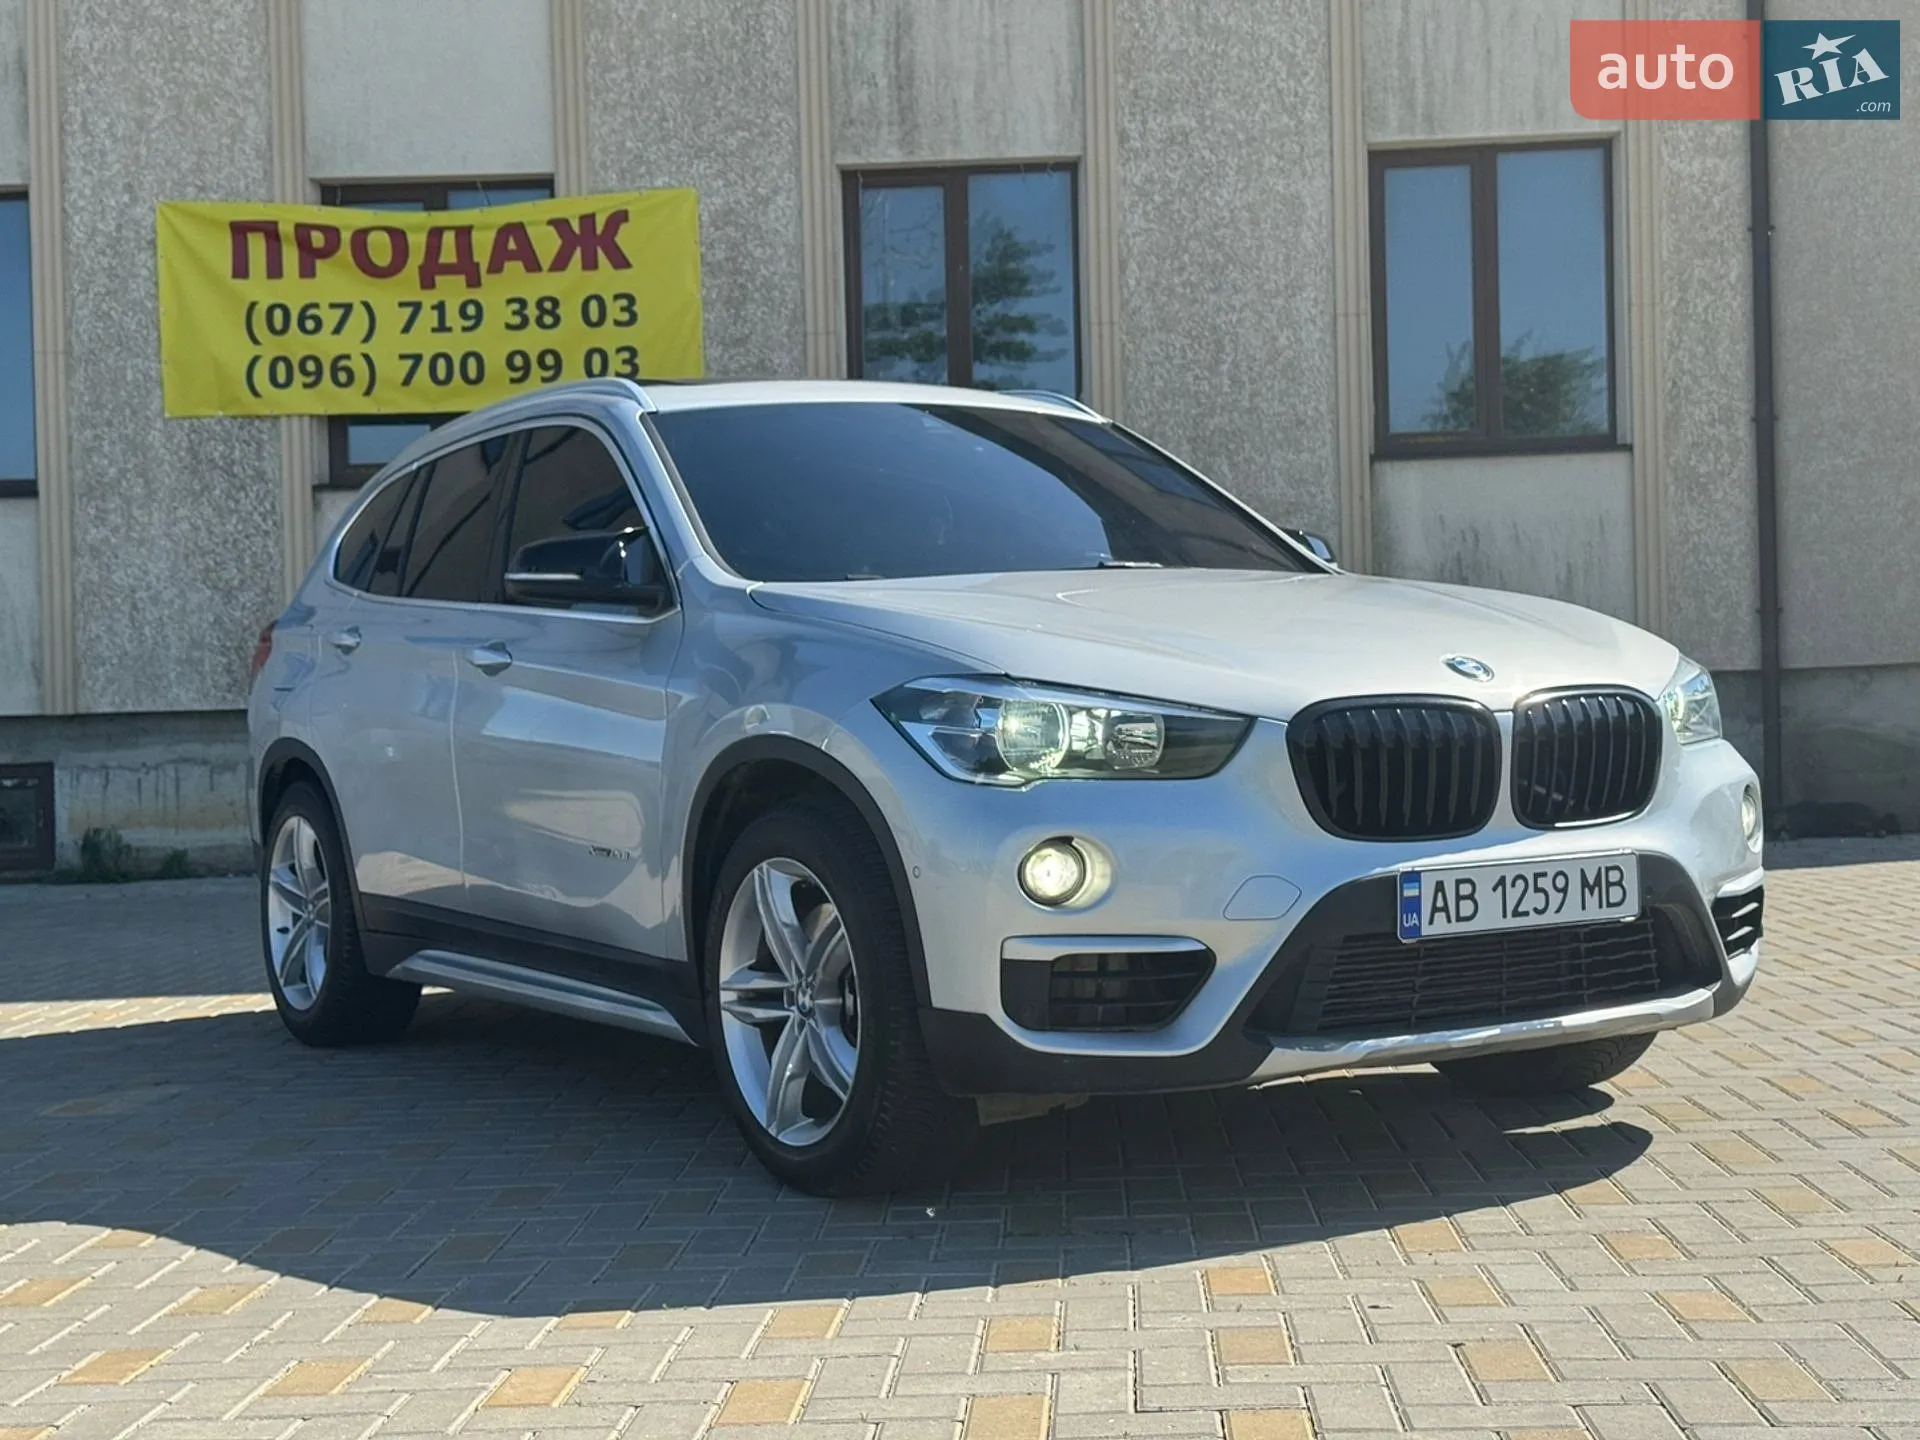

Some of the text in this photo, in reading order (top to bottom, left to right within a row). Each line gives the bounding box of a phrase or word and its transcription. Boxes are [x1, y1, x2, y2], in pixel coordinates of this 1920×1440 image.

[229, 208, 632, 290] ПРОДАЖ
[244, 292, 639, 345] (067) 719 38 03
[245, 345, 641, 398] (096) 700 99 03
[1403, 912, 1420, 927] UA
[1428, 865, 1627, 926] AB 1259 MB
